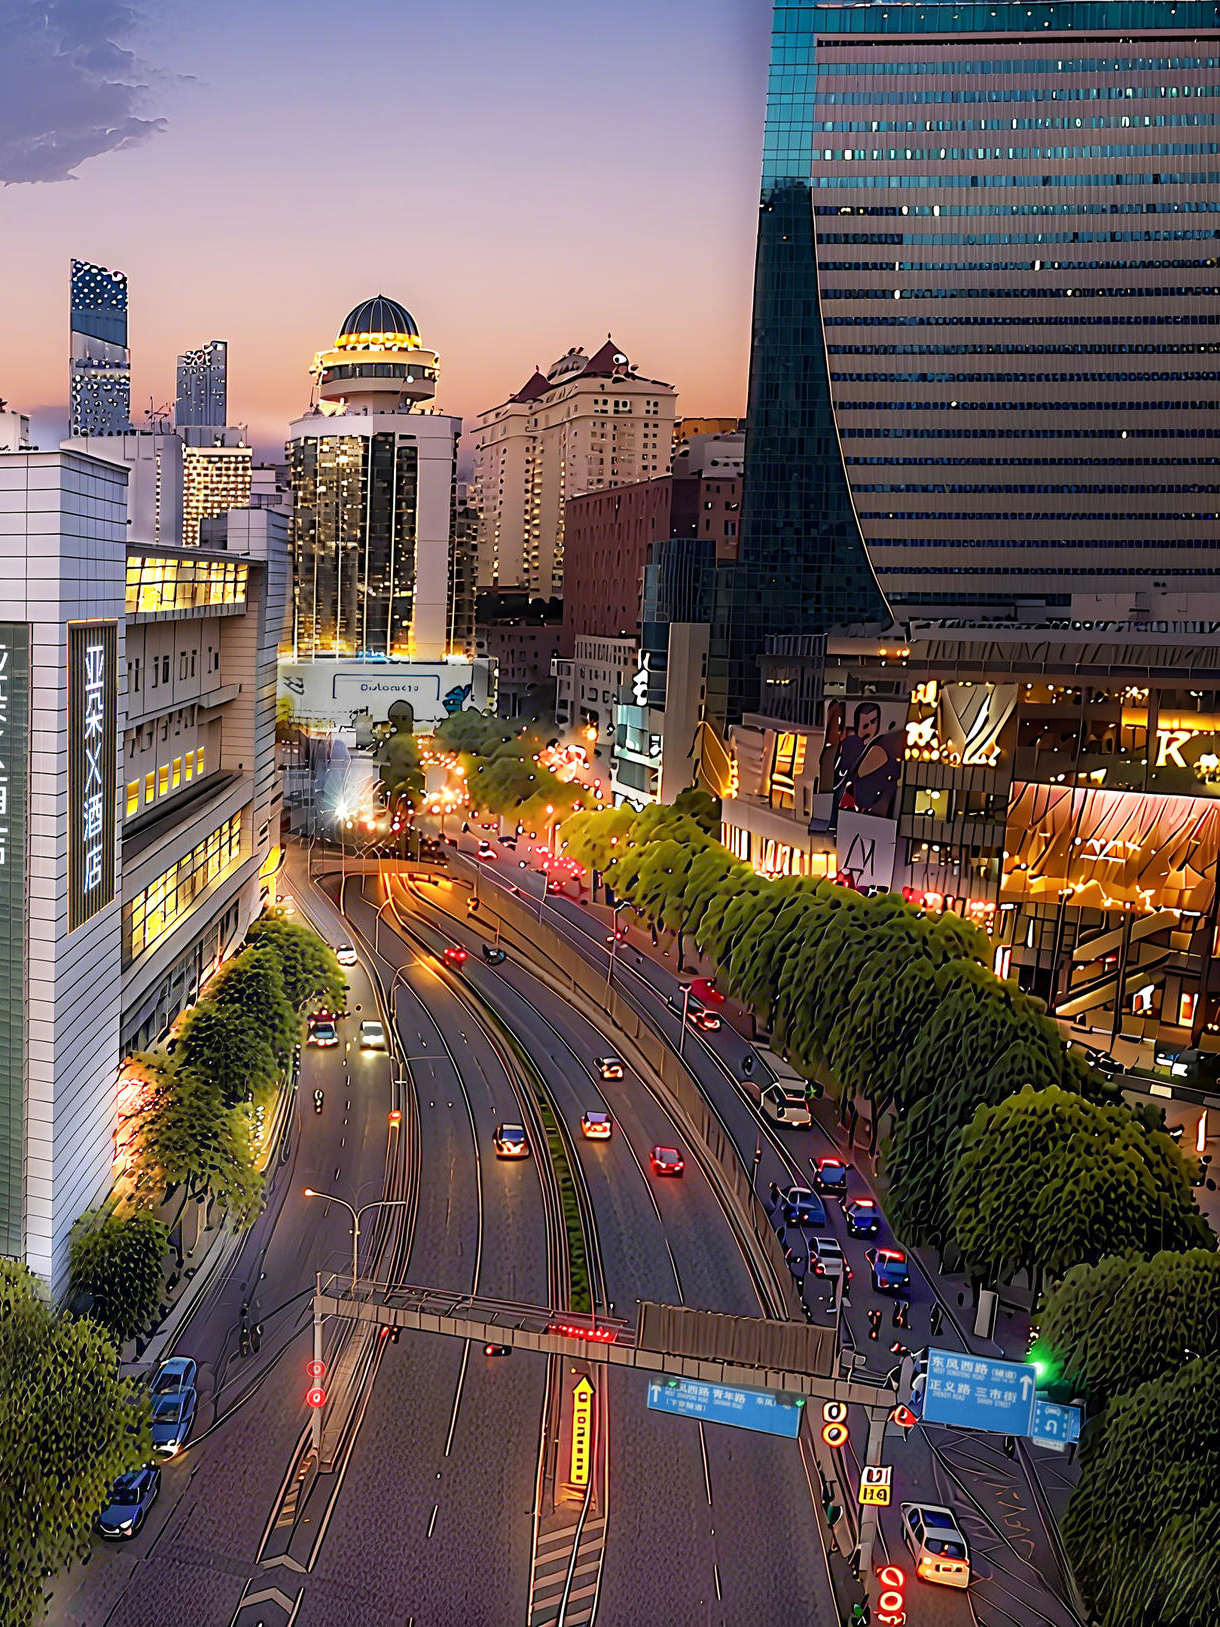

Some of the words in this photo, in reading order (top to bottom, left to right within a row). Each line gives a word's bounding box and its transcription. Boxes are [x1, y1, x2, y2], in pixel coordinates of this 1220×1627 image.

[932, 1356, 988, 1375] 东风西路
[929, 1379, 971, 1396] 正义路
[975, 1387, 1018, 1403] 三市街
